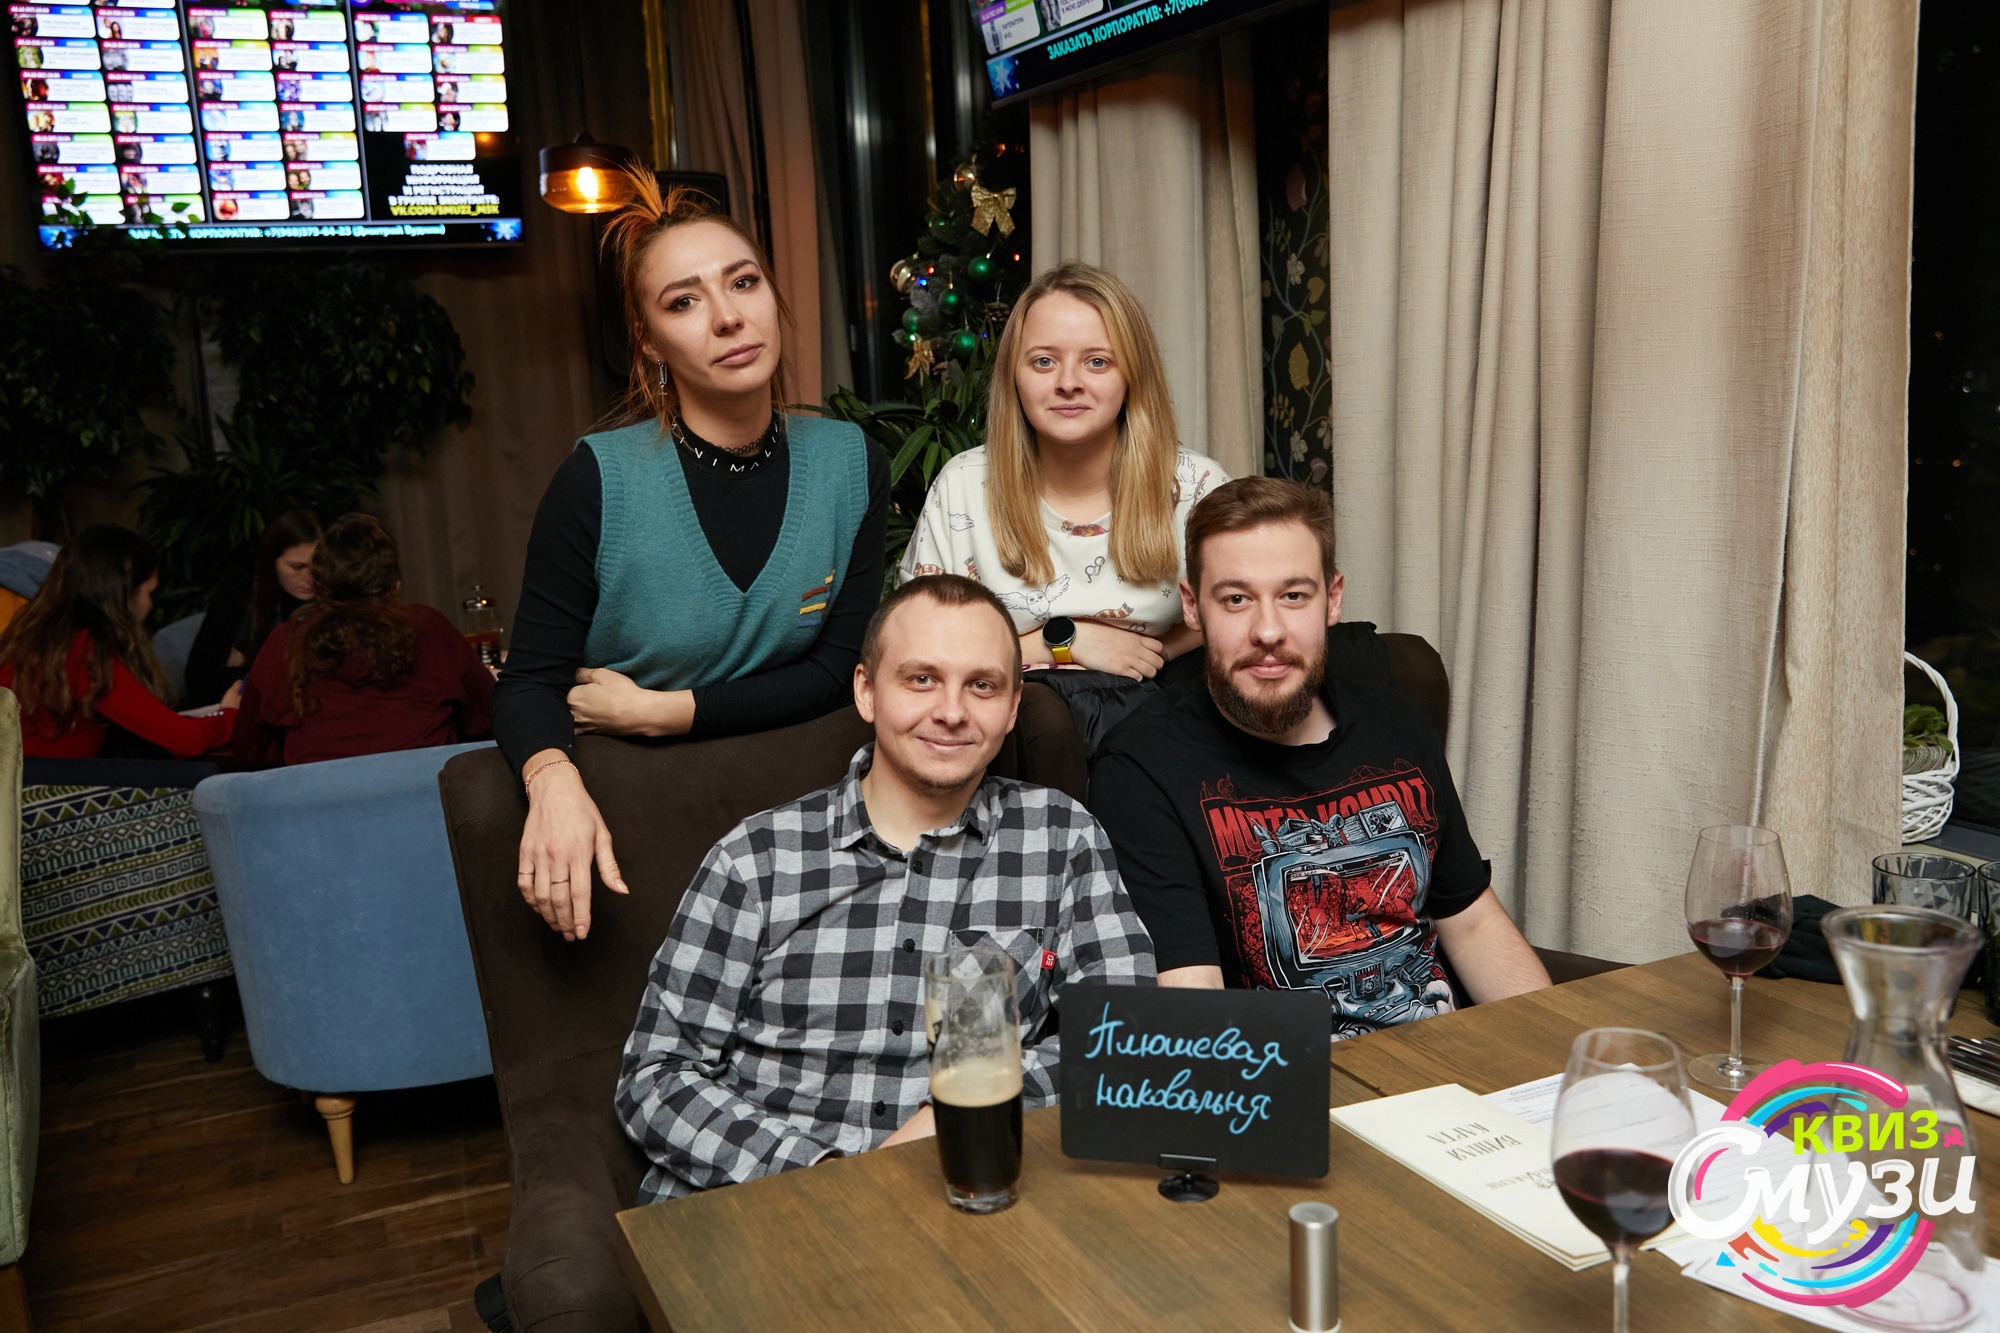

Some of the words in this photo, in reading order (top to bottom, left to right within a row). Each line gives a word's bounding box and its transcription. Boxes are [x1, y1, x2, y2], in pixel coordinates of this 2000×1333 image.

[1047, 30, 1094, 60] ЗАКАЗАТЬ
[1093, 4, 1164, 43] КОРПОРАТИВ:
[1084, 1001, 1290, 1080] Плюшевая
[1426, 1122, 1490, 1145] КАРТА
[1446, 1134, 1522, 1161] ВИННАЯ
